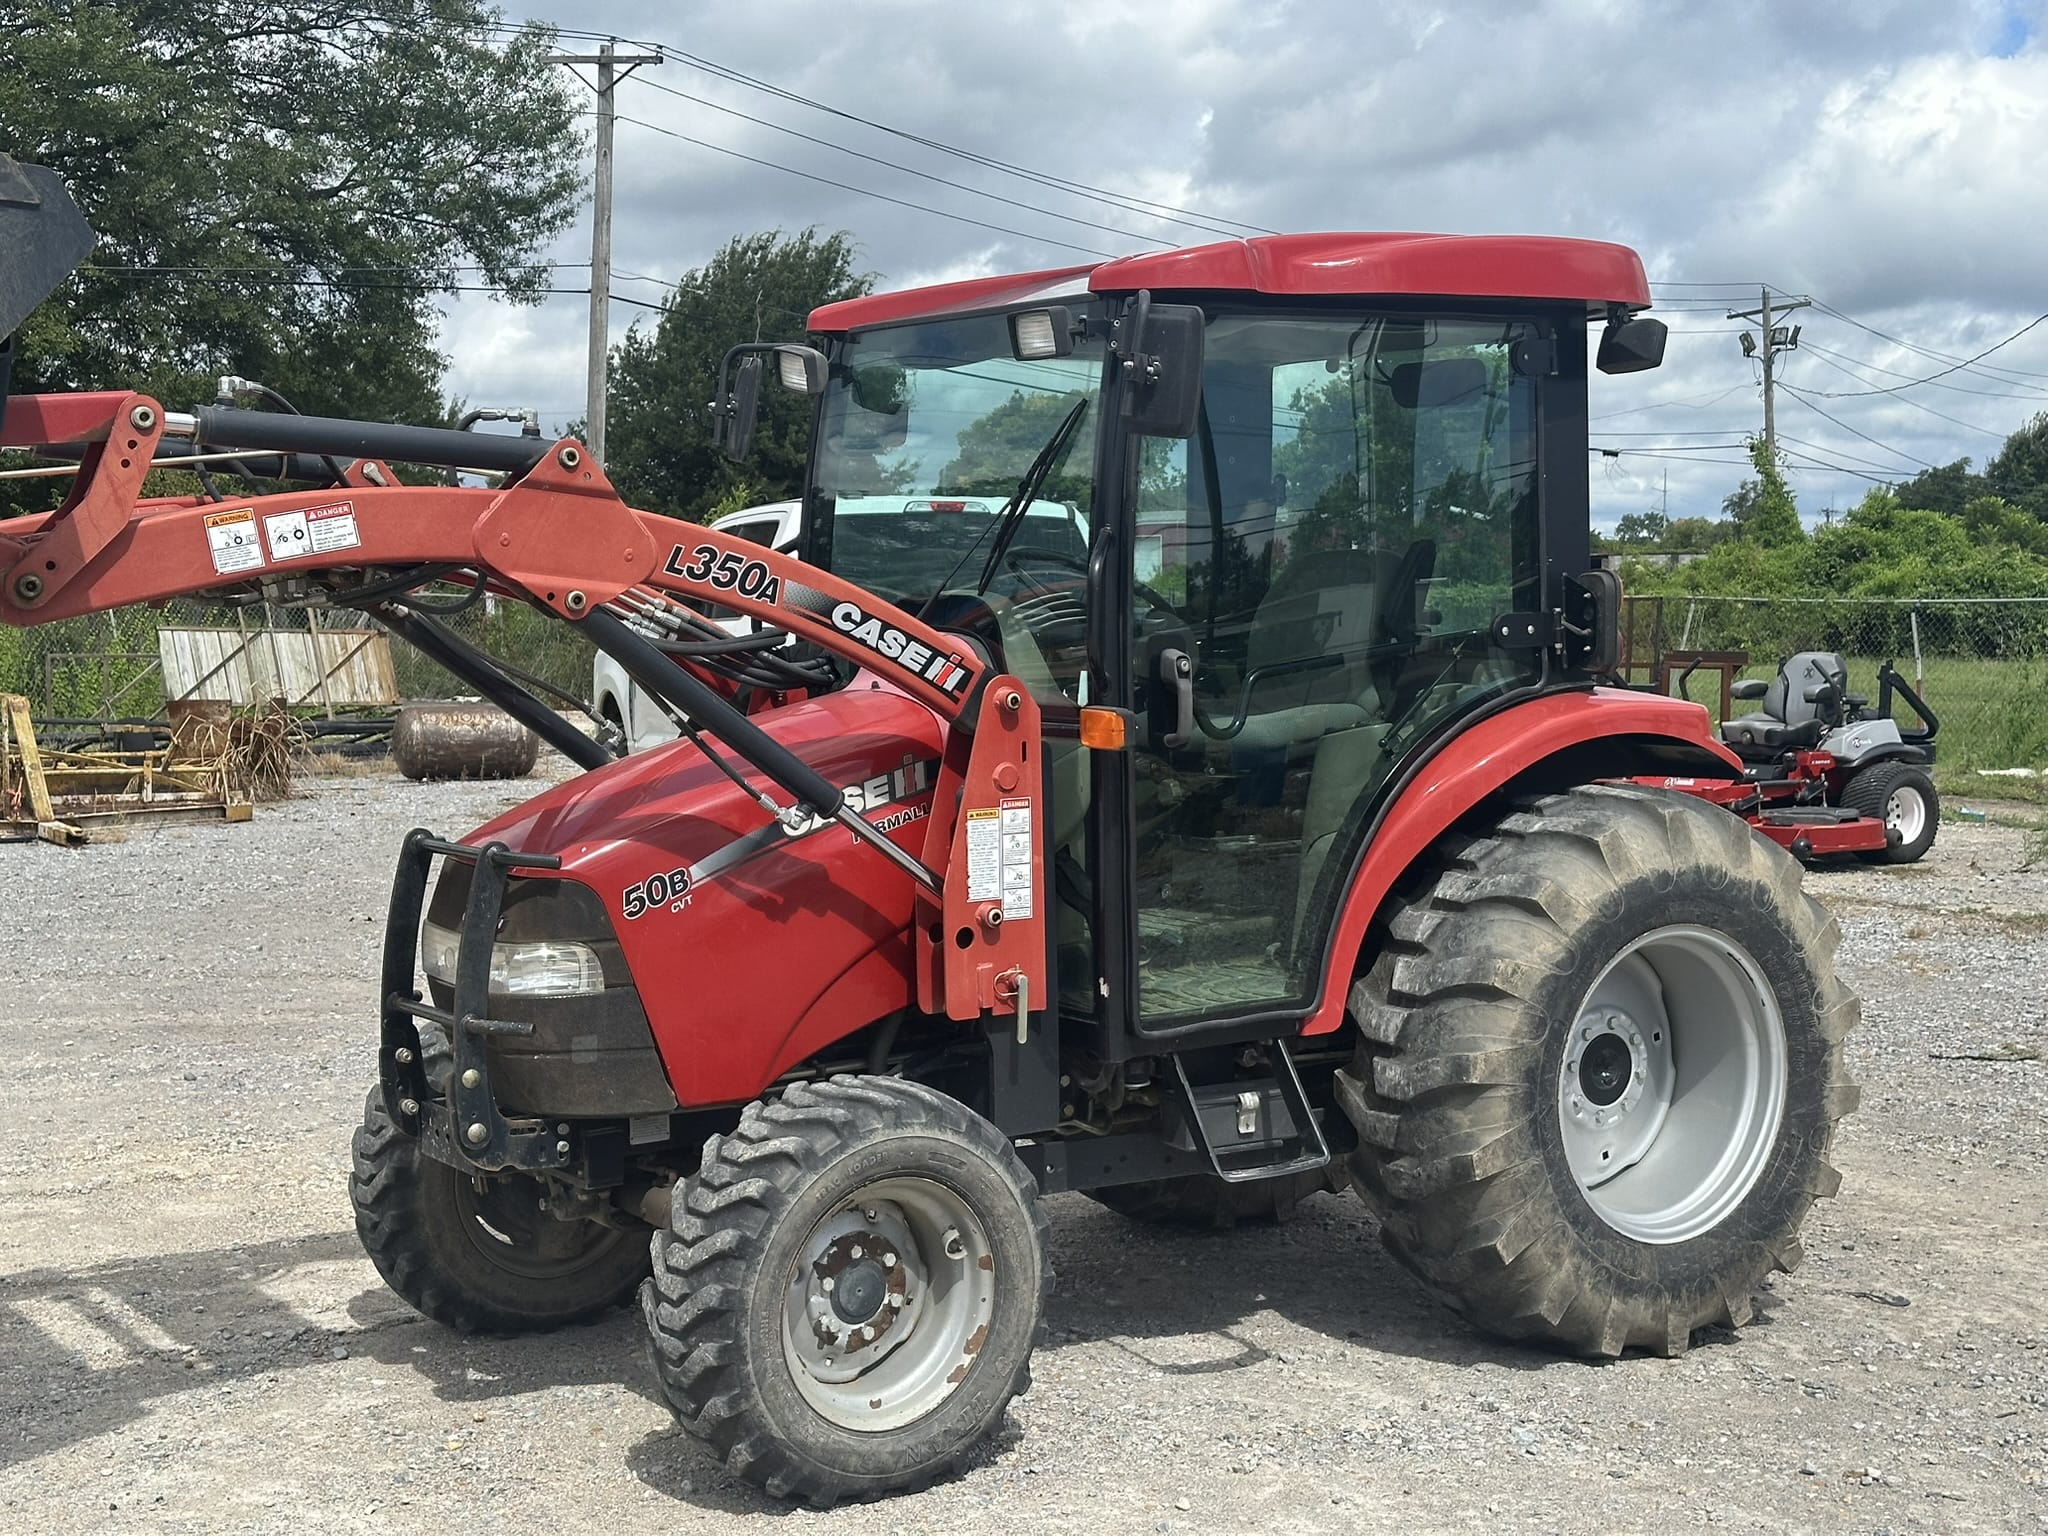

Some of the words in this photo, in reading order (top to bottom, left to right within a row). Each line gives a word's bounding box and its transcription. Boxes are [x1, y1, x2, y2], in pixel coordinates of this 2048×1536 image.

[219, 513, 249, 523] WARNING
[317, 506, 349, 517] DANGER
[664, 544, 781, 606] L350A
[832, 602, 933, 674] CASE
[782, 774, 890, 836] CSE
[851, 802, 931, 845] RMALL
[623, 867, 690, 919] 50B
[671, 894, 692, 913] CVT
